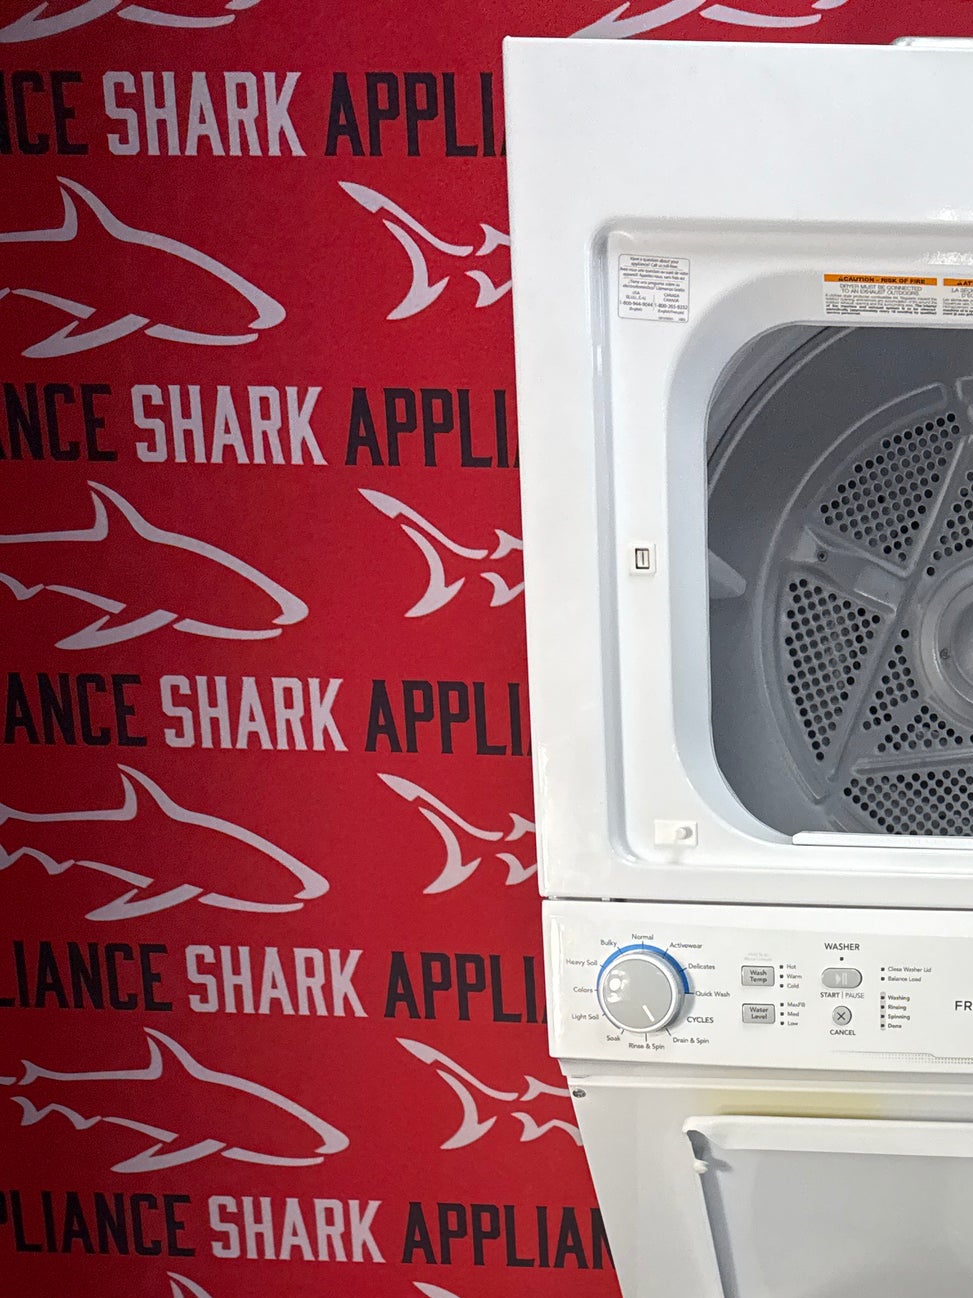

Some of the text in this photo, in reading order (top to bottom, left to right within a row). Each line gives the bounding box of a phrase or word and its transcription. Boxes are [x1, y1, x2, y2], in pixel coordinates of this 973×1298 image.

[102, 71, 306, 156] SHARK
[325, 72, 507, 157] APPLI
[0, 381, 519, 469] NCE SHARK APPLI
[3, 672, 531, 757] ANCE SHARK APPLI
[600, 939, 617, 947] Bulky
[669, 941, 703, 949] Activewear
[823, 942, 860, 951] WASHER
[565, 959, 585, 967] Heavy
[749, 969, 767, 977] Wash
[0, 940, 547, 1024] IANCE SHARK APPLI
[749, 976, 768, 984] Temp
[887, 994, 910, 1002] Washing
[686, 1016, 714, 1024] CYCLES
[887, 1013, 911, 1021] Spinning
[696, 1037, 709, 1045] Spin
[0, 1188, 196, 1257] LIANCE
[208, 1195, 386, 1262] SHARK
